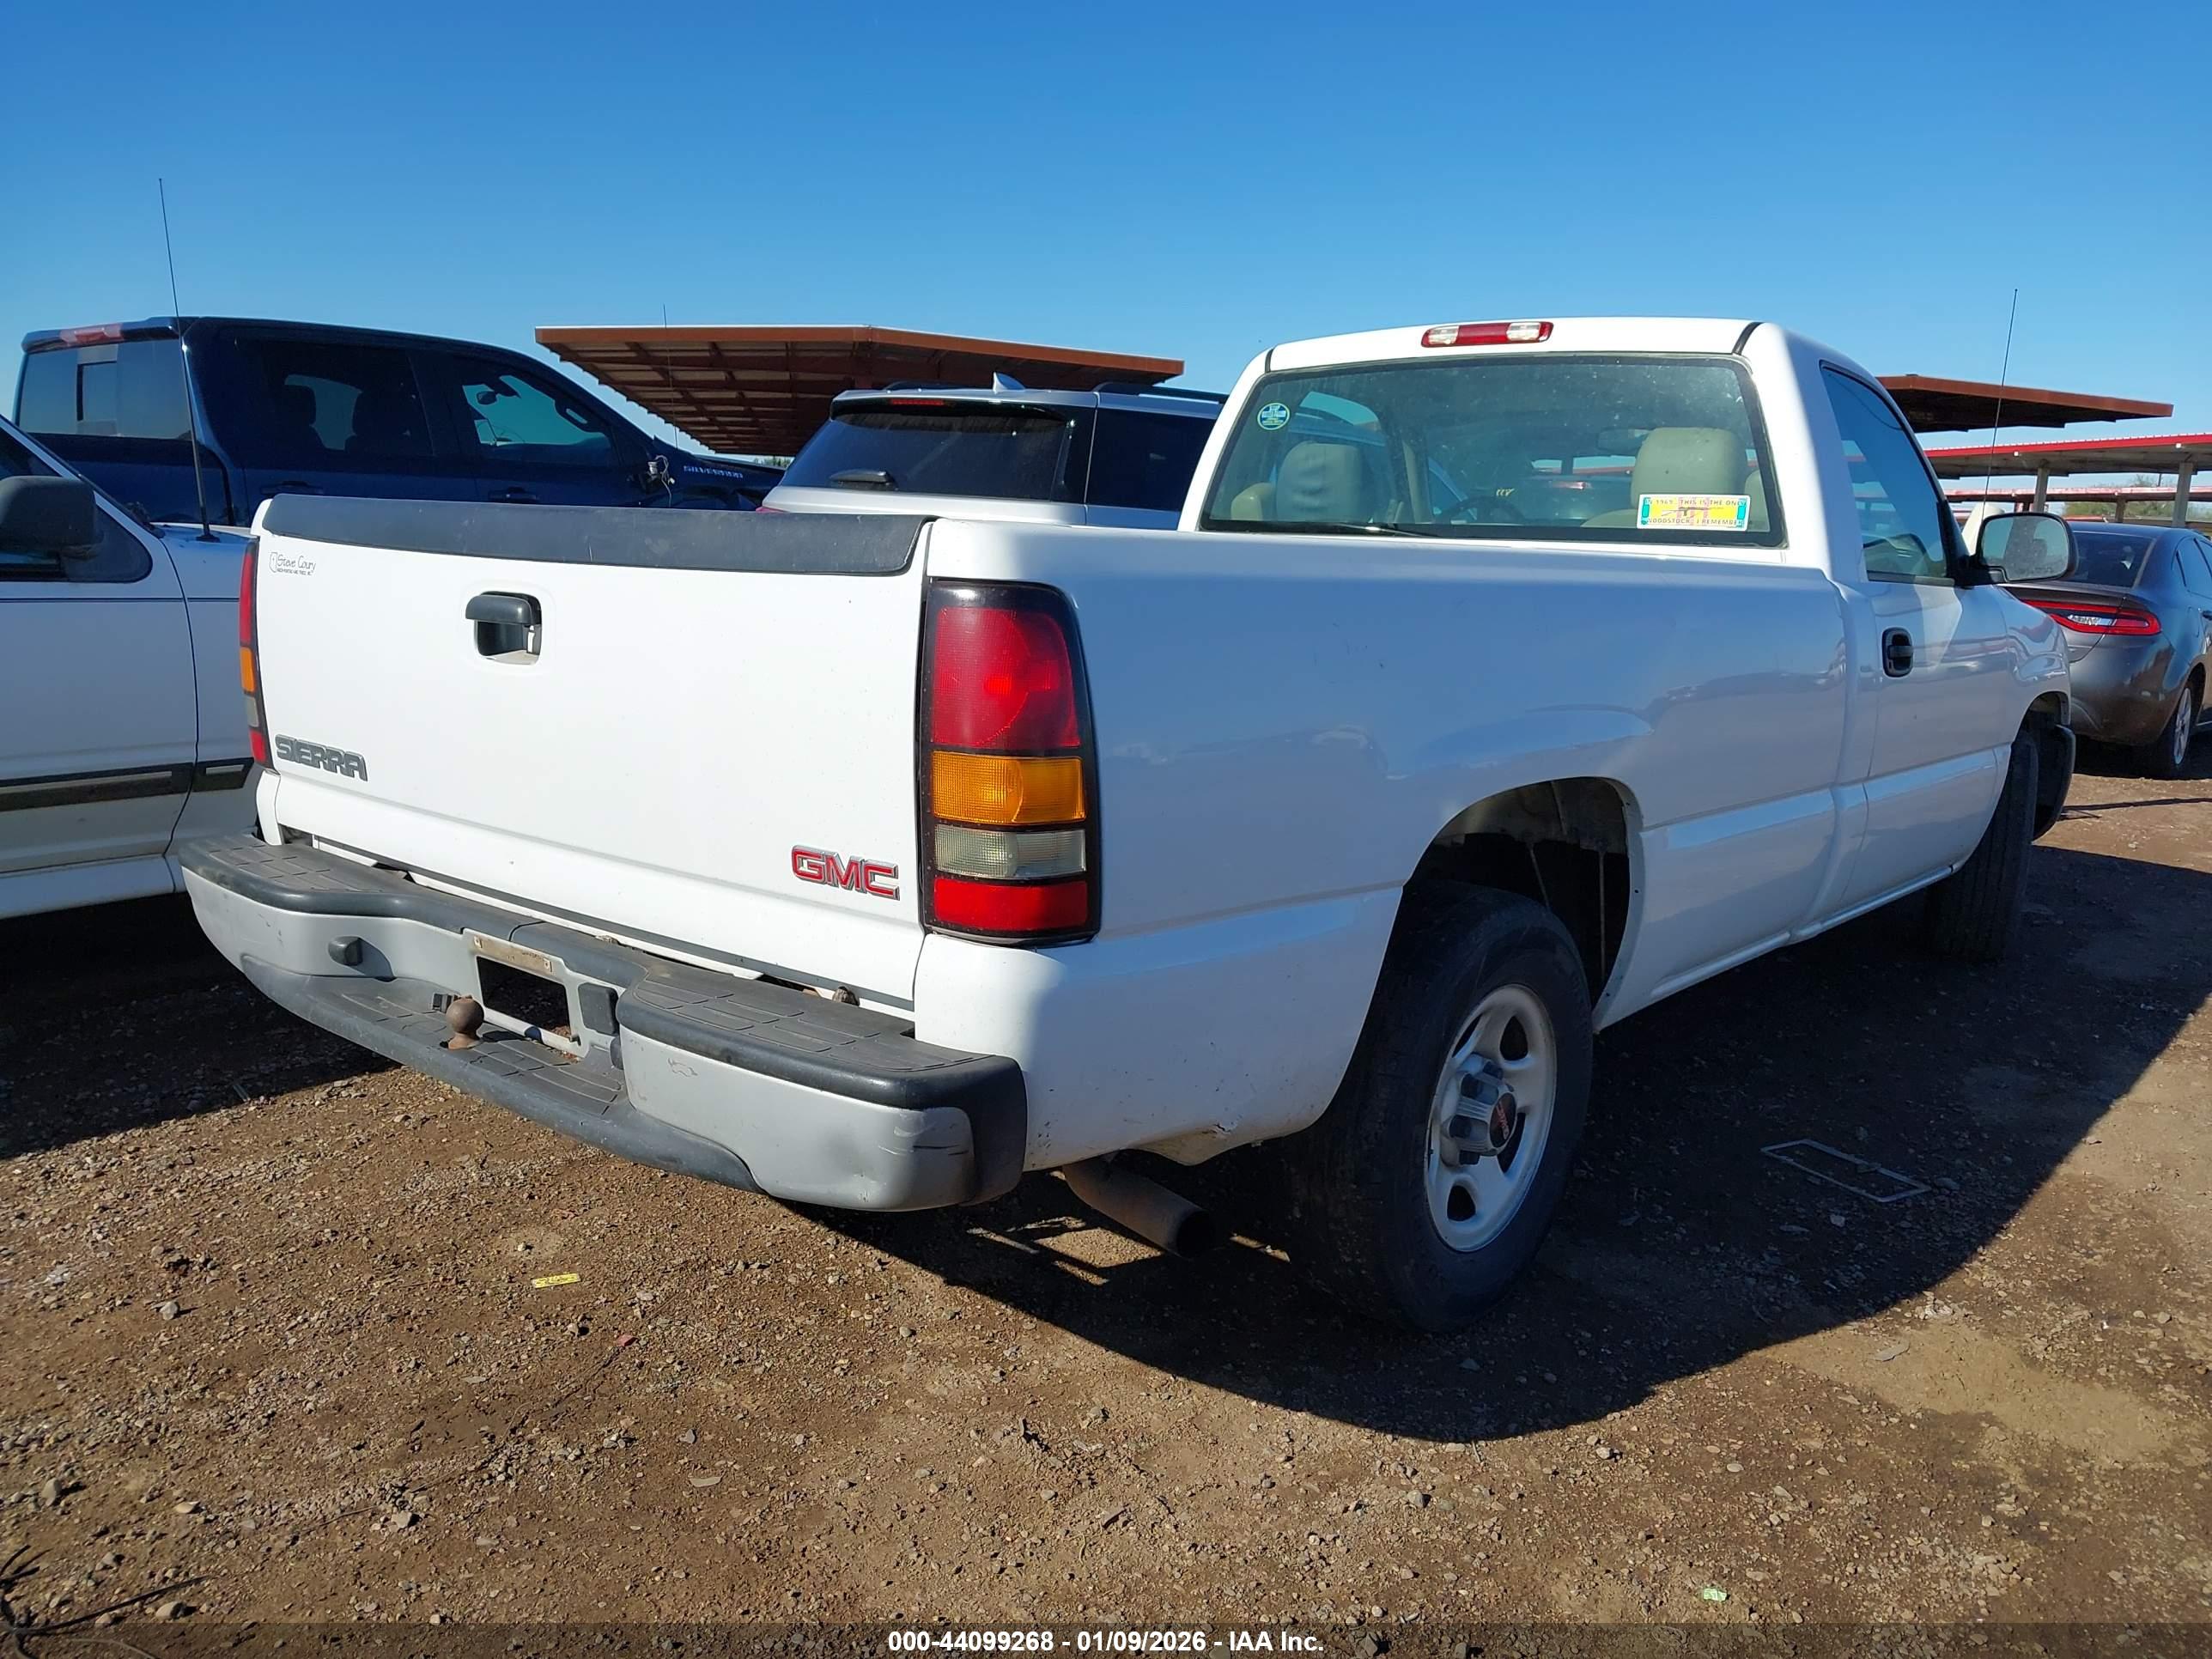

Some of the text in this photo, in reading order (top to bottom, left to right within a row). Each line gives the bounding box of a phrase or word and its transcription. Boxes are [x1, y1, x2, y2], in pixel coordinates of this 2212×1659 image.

[276, 554, 296, 568] Steve
[275, 733, 368, 782] SIERRA
[791, 844, 901, 902] GMC
